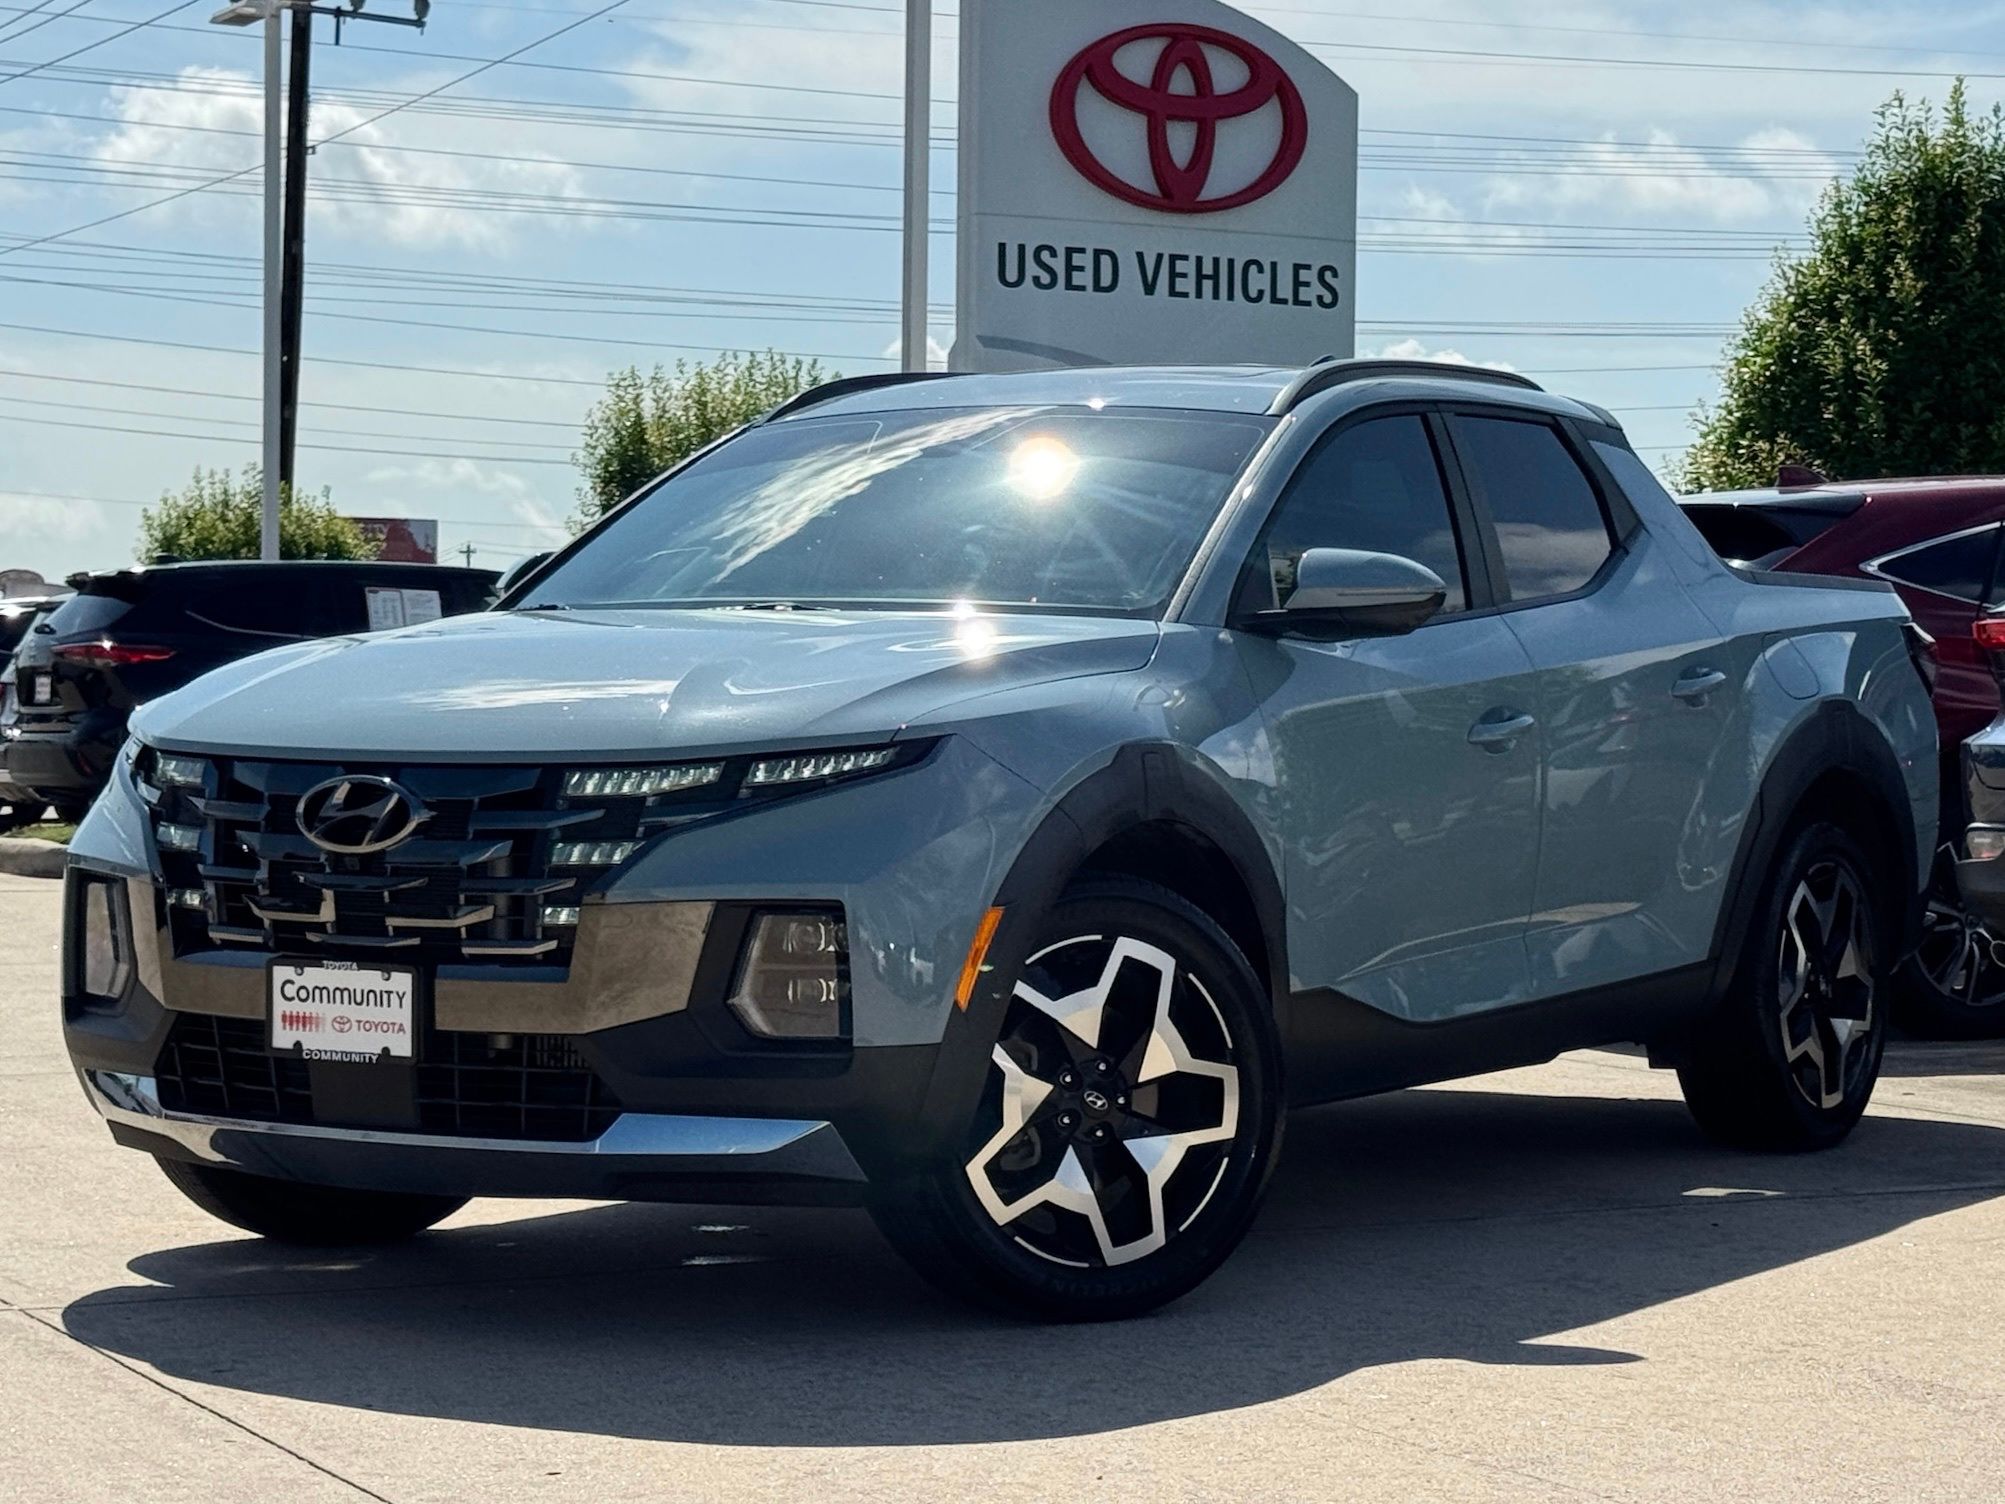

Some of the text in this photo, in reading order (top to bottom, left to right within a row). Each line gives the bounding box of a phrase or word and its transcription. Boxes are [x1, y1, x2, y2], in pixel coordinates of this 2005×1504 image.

[997, 241, 1340, 310] USED VEHICLES
[322, 960, 359, 971] TOYOTA
[355, 1019, 406, 1035] TOYOTA
[302, 1048, 379, 1064] COMMUNITY
